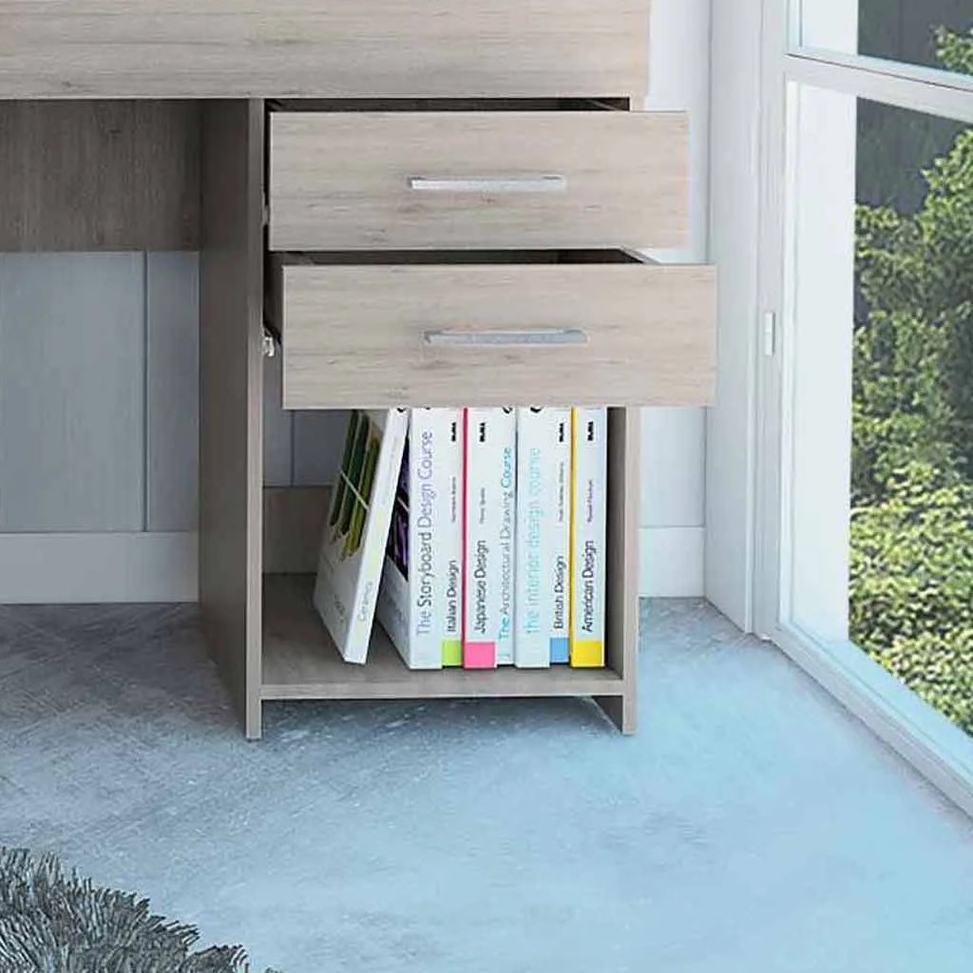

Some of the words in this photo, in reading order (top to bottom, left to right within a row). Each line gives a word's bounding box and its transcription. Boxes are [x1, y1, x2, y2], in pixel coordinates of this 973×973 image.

[417, 431, 432, 480] Course
[500, 447, 512, 489] Course
[417, 484, 435, 529] Design
[500, 492, 513, 540] Drawing
[417, 533, 435, 608] Storyboard
[446, 560, 459, 598] Design
[474, 540, 488, 579] Design
[499, 542, 511, 616] Architectural
[553, 556, 566, 593] Design
[582, 540, 596, 579] Design
[417, 611, 430, 636] The
[446, 600, 457, 633] Italian
[474, 580, 488, 635] Japanese
[553, 595, 564, 630] British
[582, 581, 594, 633] American
[498, 617, 510, 640] The
